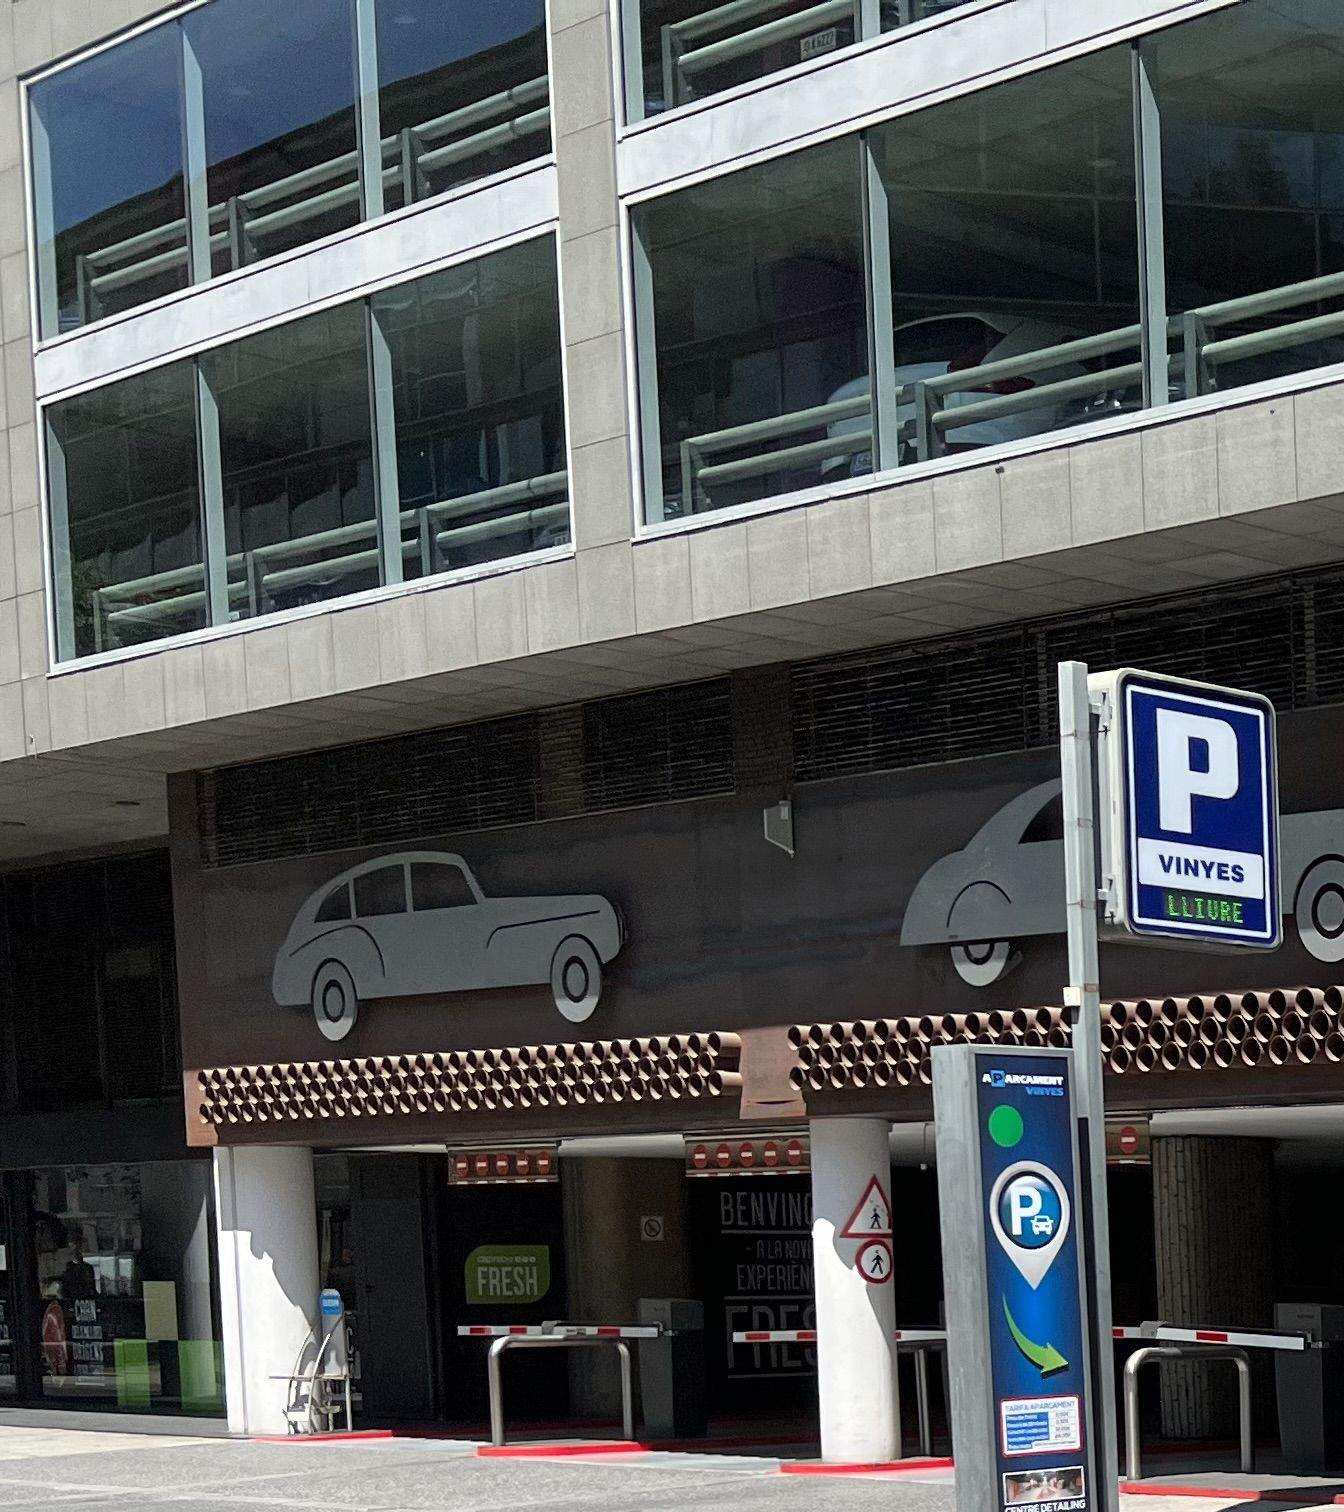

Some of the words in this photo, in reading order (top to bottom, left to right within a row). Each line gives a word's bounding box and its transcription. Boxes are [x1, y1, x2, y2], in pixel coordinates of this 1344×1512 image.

[1156, 708, 1239, 834] P
[1159, 854, 1244, 883] VINYES
[1167, 895, 1243, 924] LLIURE
[1011, 1186, 1041, 1235] P
[477, 1266, 538, 1296] FRESH
[726, 1305, 816, 1369] FRES
